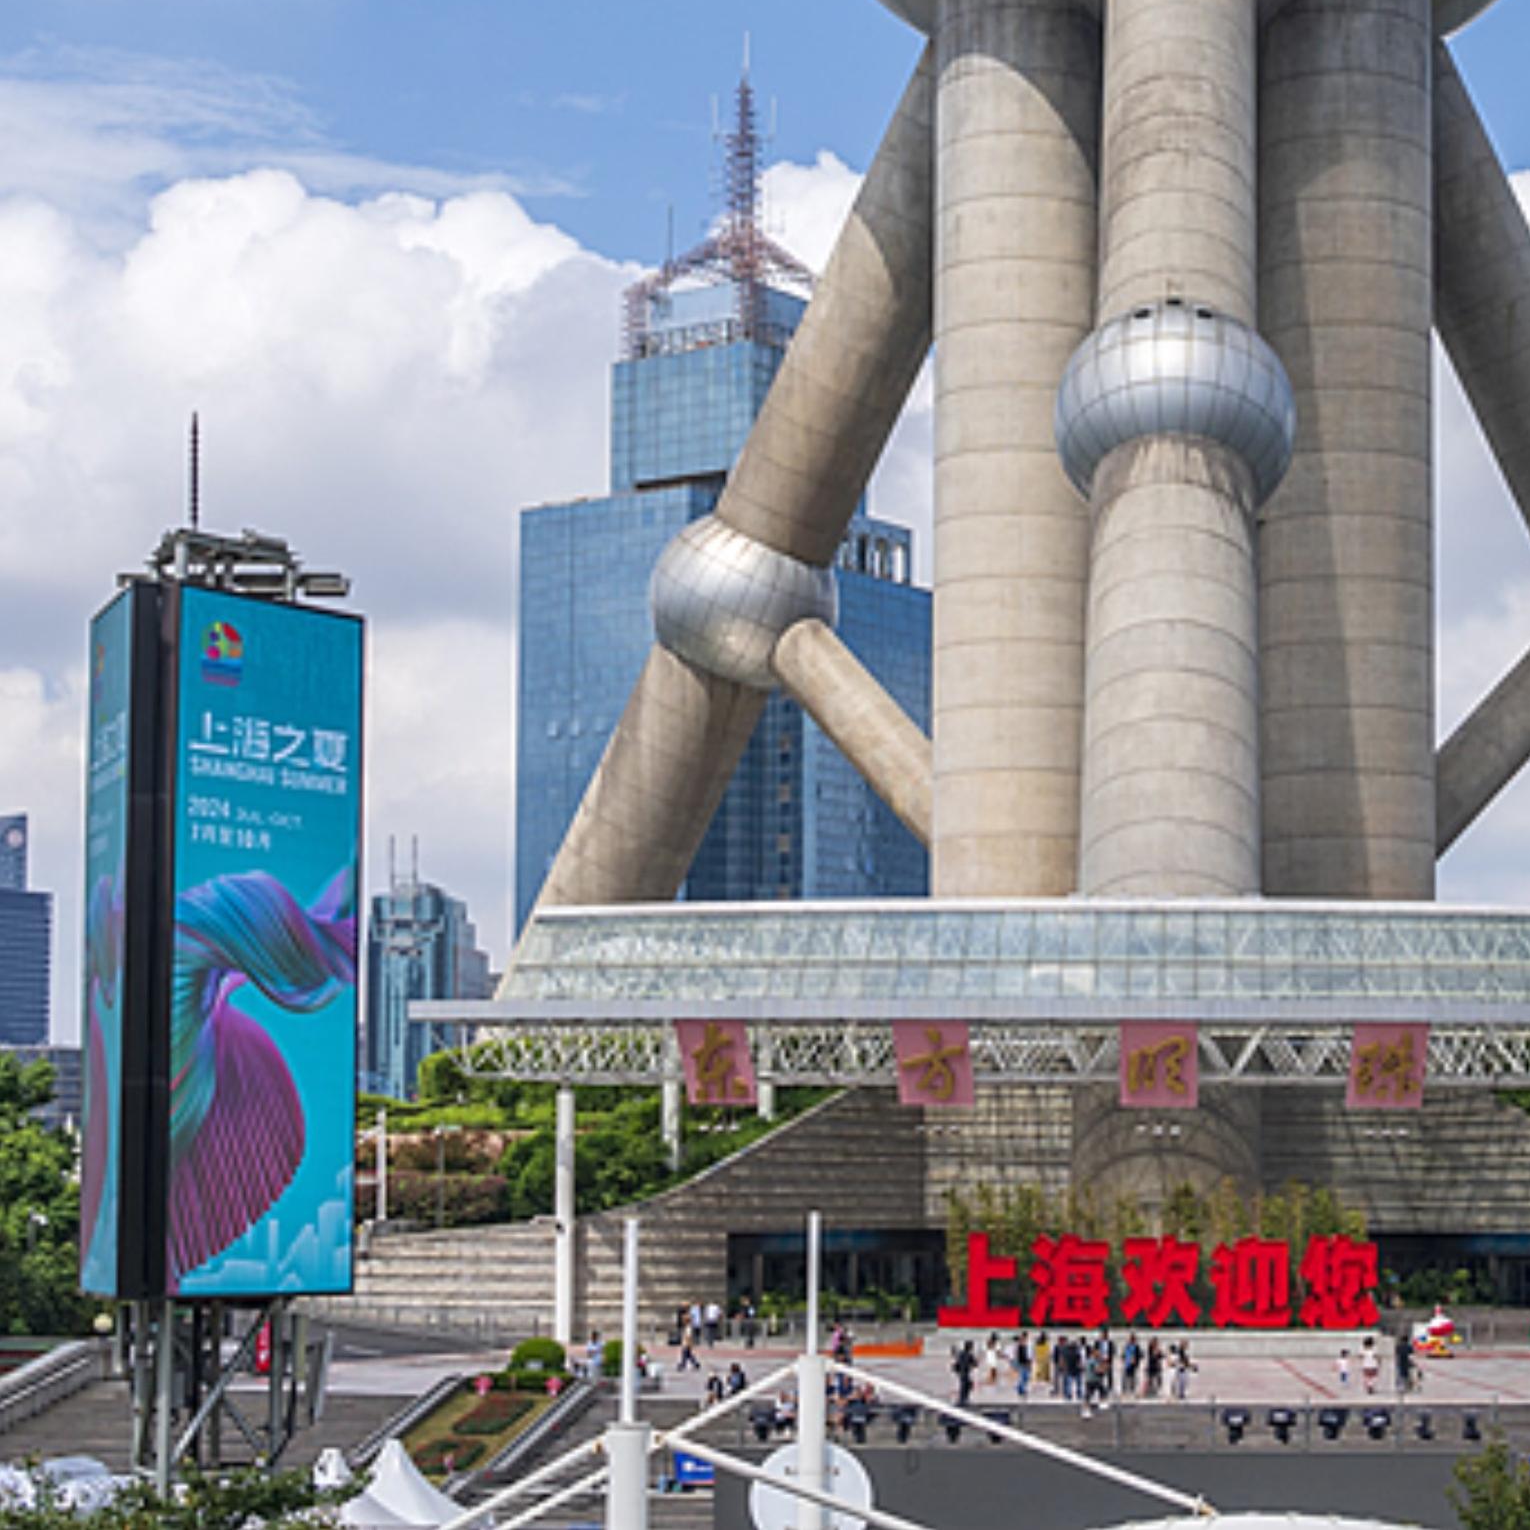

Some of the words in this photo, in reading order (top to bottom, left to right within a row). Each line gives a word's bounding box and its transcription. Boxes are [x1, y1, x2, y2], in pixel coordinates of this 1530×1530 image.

[188, 711, 348, 773] 上海之夏
[188, 755, 276, 787] SHANGHAI
[280, 766, 347, 794] SUMMER
[187, 793, 231, 819] 2024
[937, 1231, 1381, 1329] 上海欢迎您
